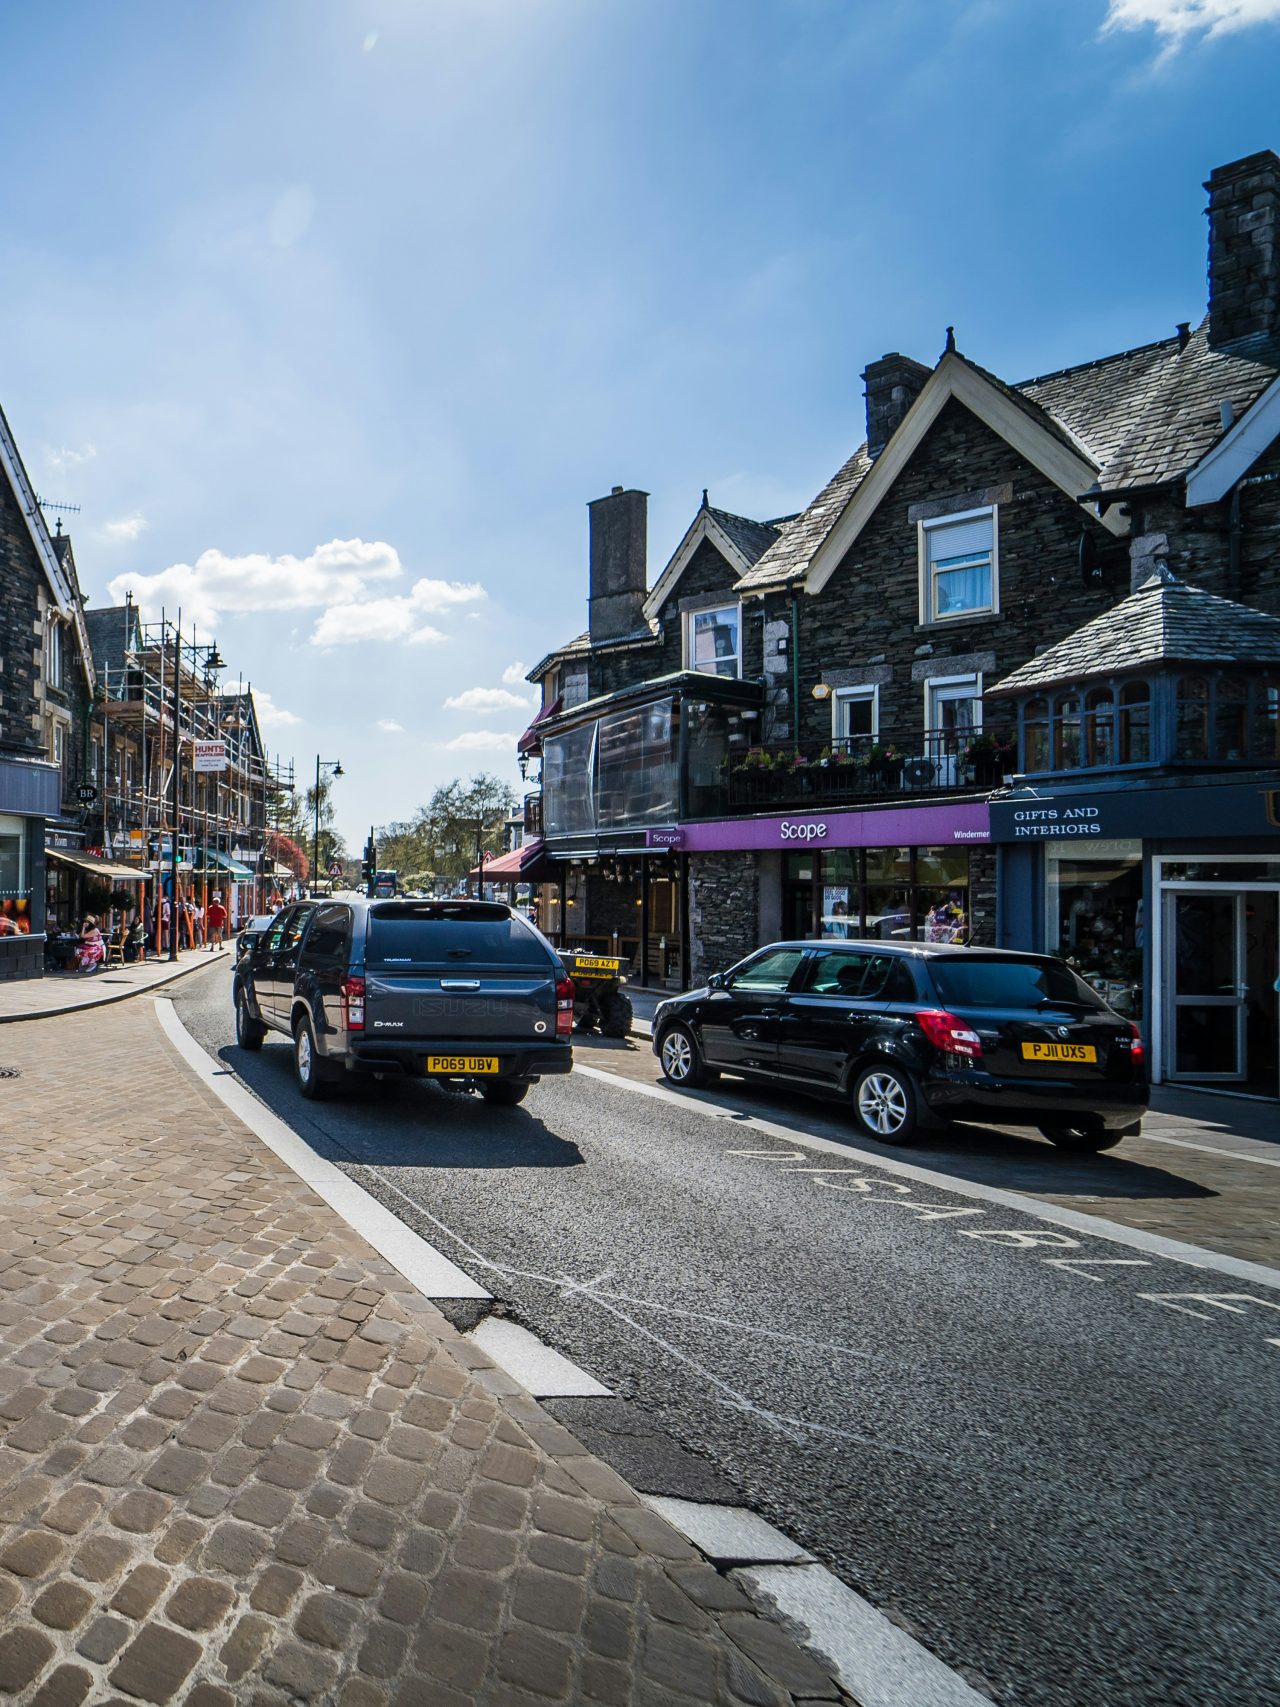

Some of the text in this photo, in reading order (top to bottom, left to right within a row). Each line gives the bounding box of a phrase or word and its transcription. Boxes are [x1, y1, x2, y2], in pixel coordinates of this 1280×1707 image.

[80, 789, 93, 798] BR
[1014, 807, 1099, 821] GIFTS AND
[781, 822, 827, 842] Scope
[954, 830, 991, 840] Windermer
[1015, 823, 1101, 836] INTERIORS
[652, 834, 681, 844] Scope
[579, 958, 615, 968] PO69 AZT
[1061, 1045, 1086, 1059] UXS
[433, 1058, 493, 1071] PO69 UBV
[727, 1150, 1280, 1347] DISABLE
